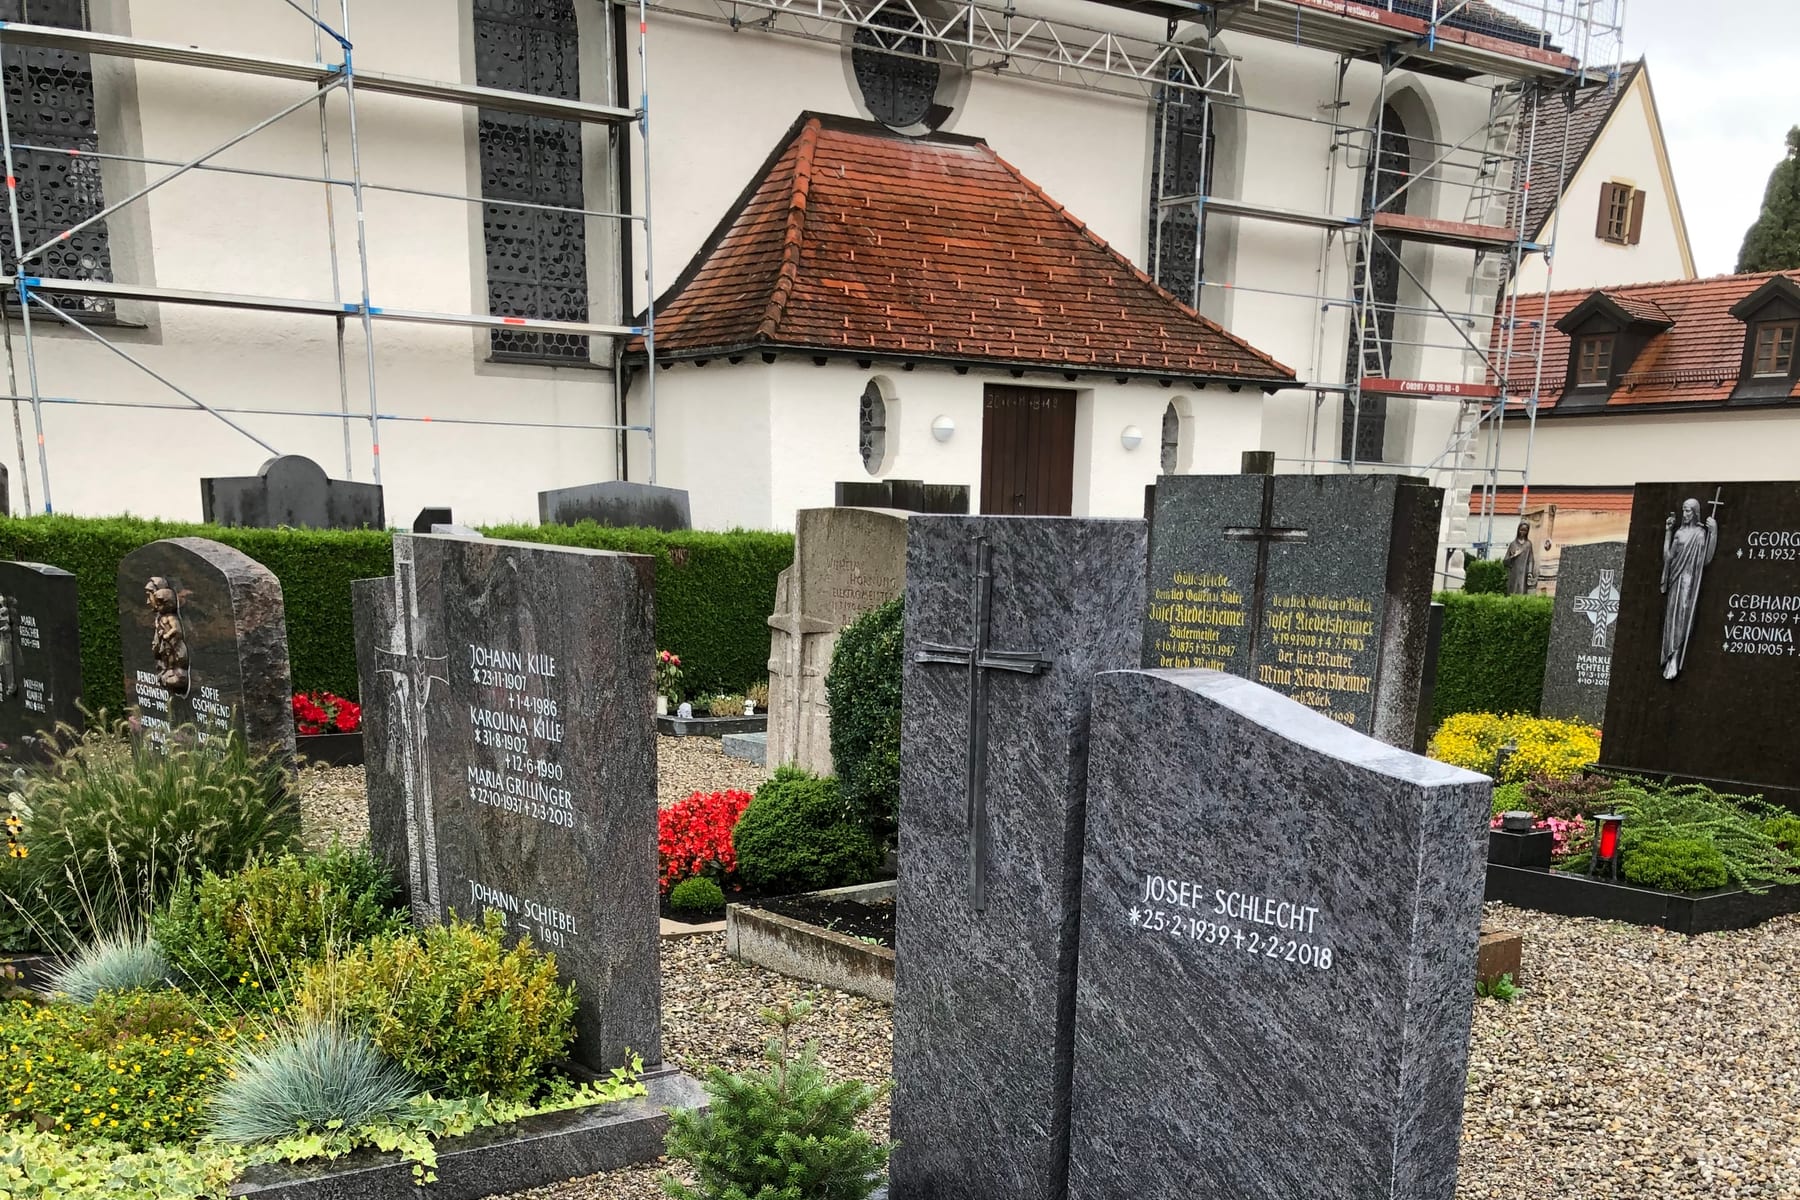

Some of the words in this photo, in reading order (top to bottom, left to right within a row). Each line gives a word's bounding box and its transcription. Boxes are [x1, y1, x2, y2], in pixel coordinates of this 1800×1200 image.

[1748, 531, 1800, 547] GEORG
[1729, 593, 1800, 611] GEBHARD
[1724, 625, 1793, 642] VERONIKA
[469, 644, 521, 672] JOHANN
[527, 652, 556, 677] KILLE
[1160, 655, 1174, 667] der
[1278, 649, 1293, 663] der
[1316, 652, 1353, 668] Mutter
[1576, 663, 1611, 672] ECHTELE
[1577, 655, 1611, 664] MARKU
[136, 670, 161, 686] BENEDI
[1258, 665, 1291, 685] Mina
[1293, 669, 1372, 693] Riedelsheimer
[135, 683, 169, 702] GSCHWEND
[200, 686, 220, 702] SOFIE
[192, 697, 231, 718] GSCHWEND
[470, 705, 529, 736] KAROLINA
[533, 717, 562, 742] KILLE
[468, 766, 505, 791] MARIA
[506, 776, 573, 810] GRILLINGER
[469, 880, 519, 914] JOHANN
[524, 899, 578, 935] SCHIEBEL
[1142, 875, 1203, 909] JOSEF
[1213, 888, 1319, 933] SCHLECHT
[540, 925, 565, 948] 1991
